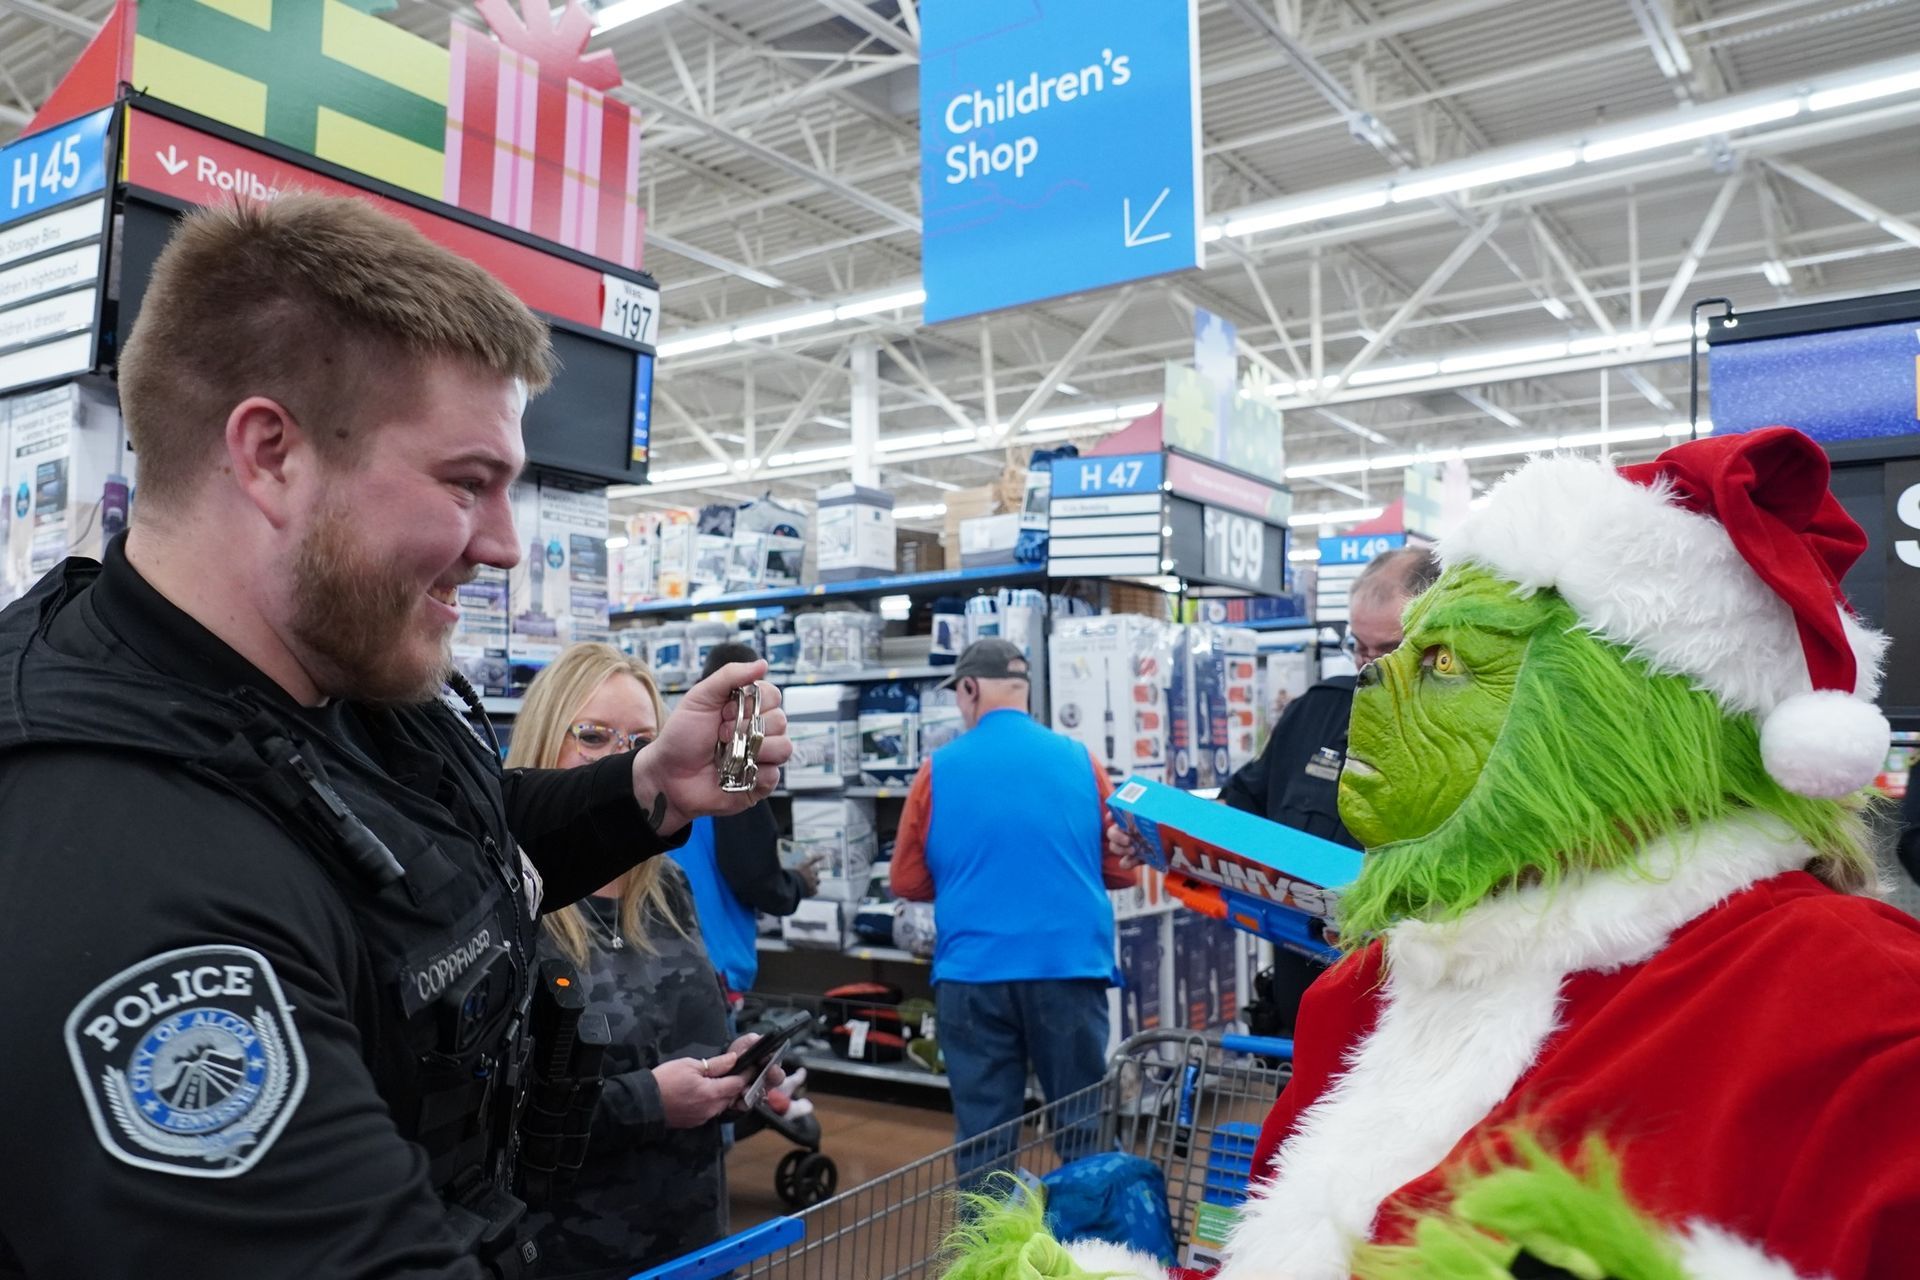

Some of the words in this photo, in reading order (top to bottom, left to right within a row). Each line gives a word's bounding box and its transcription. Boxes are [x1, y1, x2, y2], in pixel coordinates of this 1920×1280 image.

[945, 48, 1131, 134] Children's
[11, 152, 38, 210] H
[40, 133, 81, 195] 45
[197, 155, 280, 202] Rollba
[945, 136, 1038, 184] Shop
[1080, 464, 1102, 491] H
[1107, 461, 1144, 489] 47
[1204, 511, 1264, 583] $199
[1341, 540, 1359, 561] H
[1171, 846, 1338, 918] SANITY
[84, 965, 254, 1053] POLICE
[133, 1048, 156, 1093] CITY
[155, 1018, 184, 1042] OF
[191, 1012, 257, 1049] ALCOA
